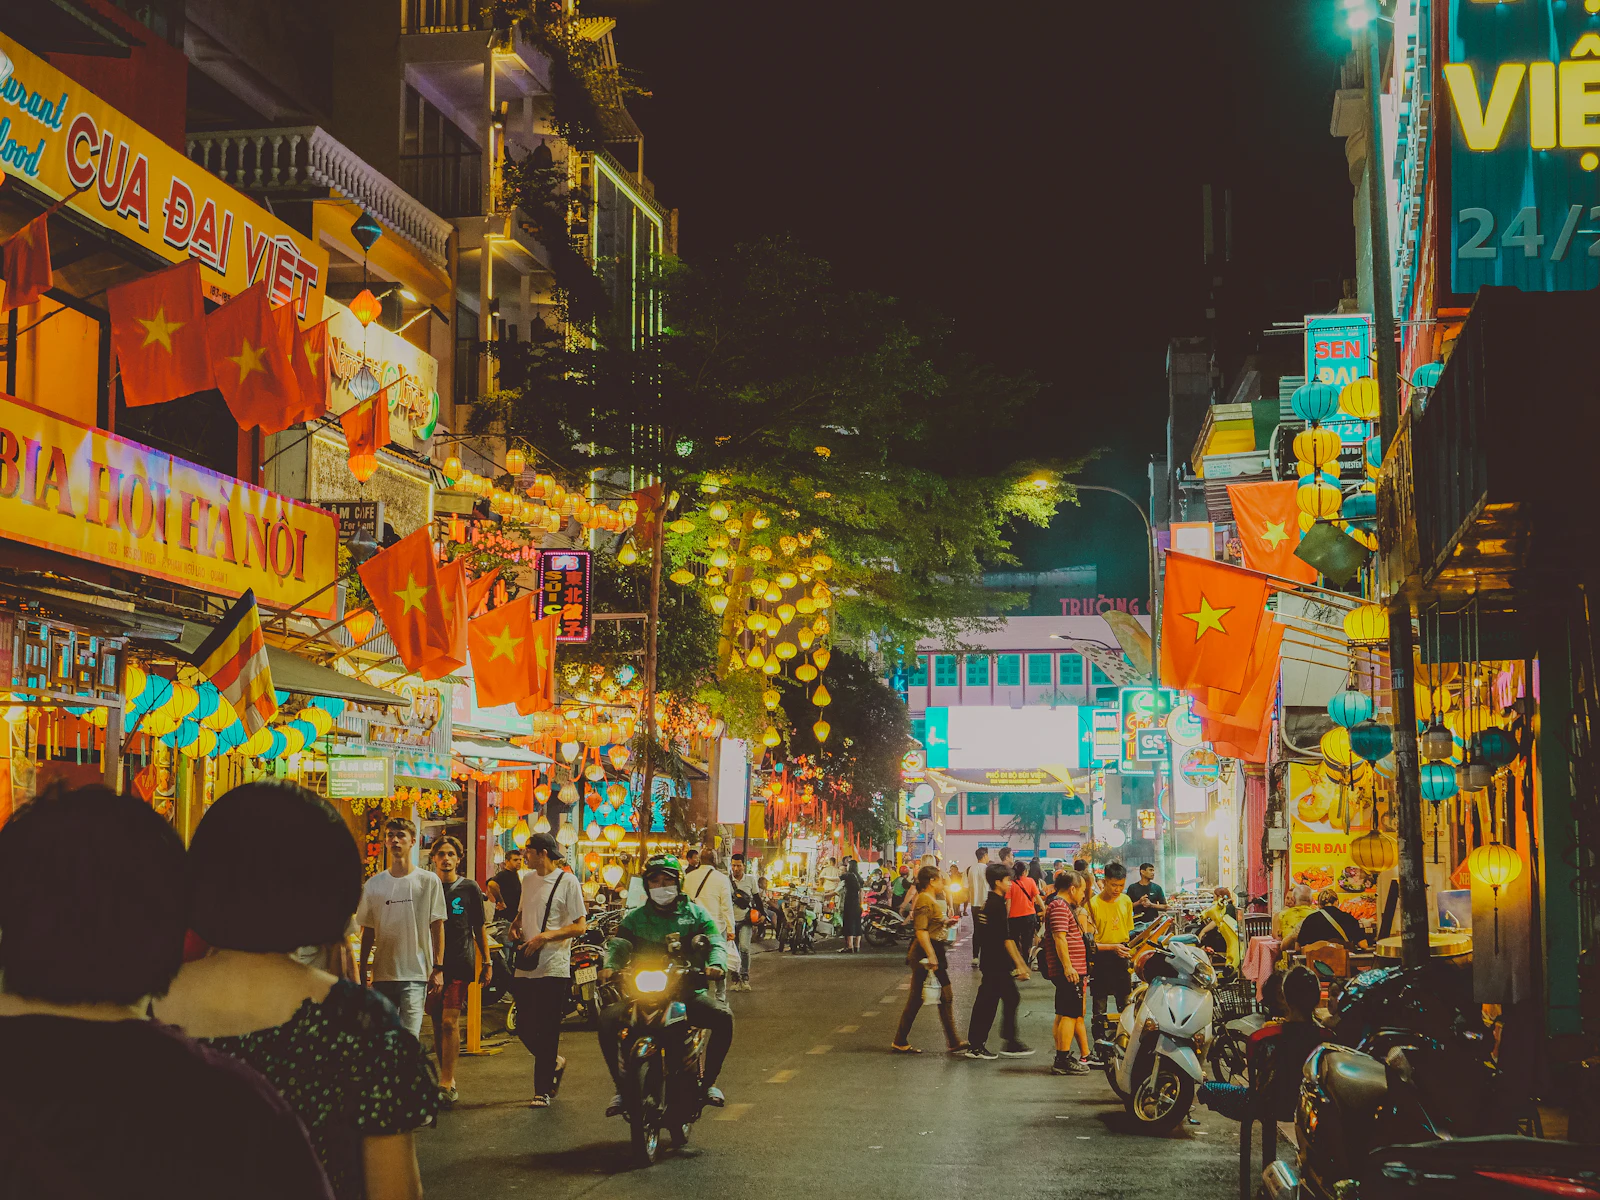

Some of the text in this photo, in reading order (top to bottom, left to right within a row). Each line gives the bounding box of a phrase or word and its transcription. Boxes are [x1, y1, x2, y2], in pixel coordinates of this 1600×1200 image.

[66, 112, 149, 233] CUA
[1315, 341, 1361, 359] SEN
[0, 427, 76, 518] BIA
[179, 485, 237, 565] HÀ
[243, 507, 307, 588] NỘI
[354, 504, 375, 519] CAFÉ
[362, 760, 384, 771] CAFÉ
[1295, 843, 1347, 857] SEN ĐẠI
